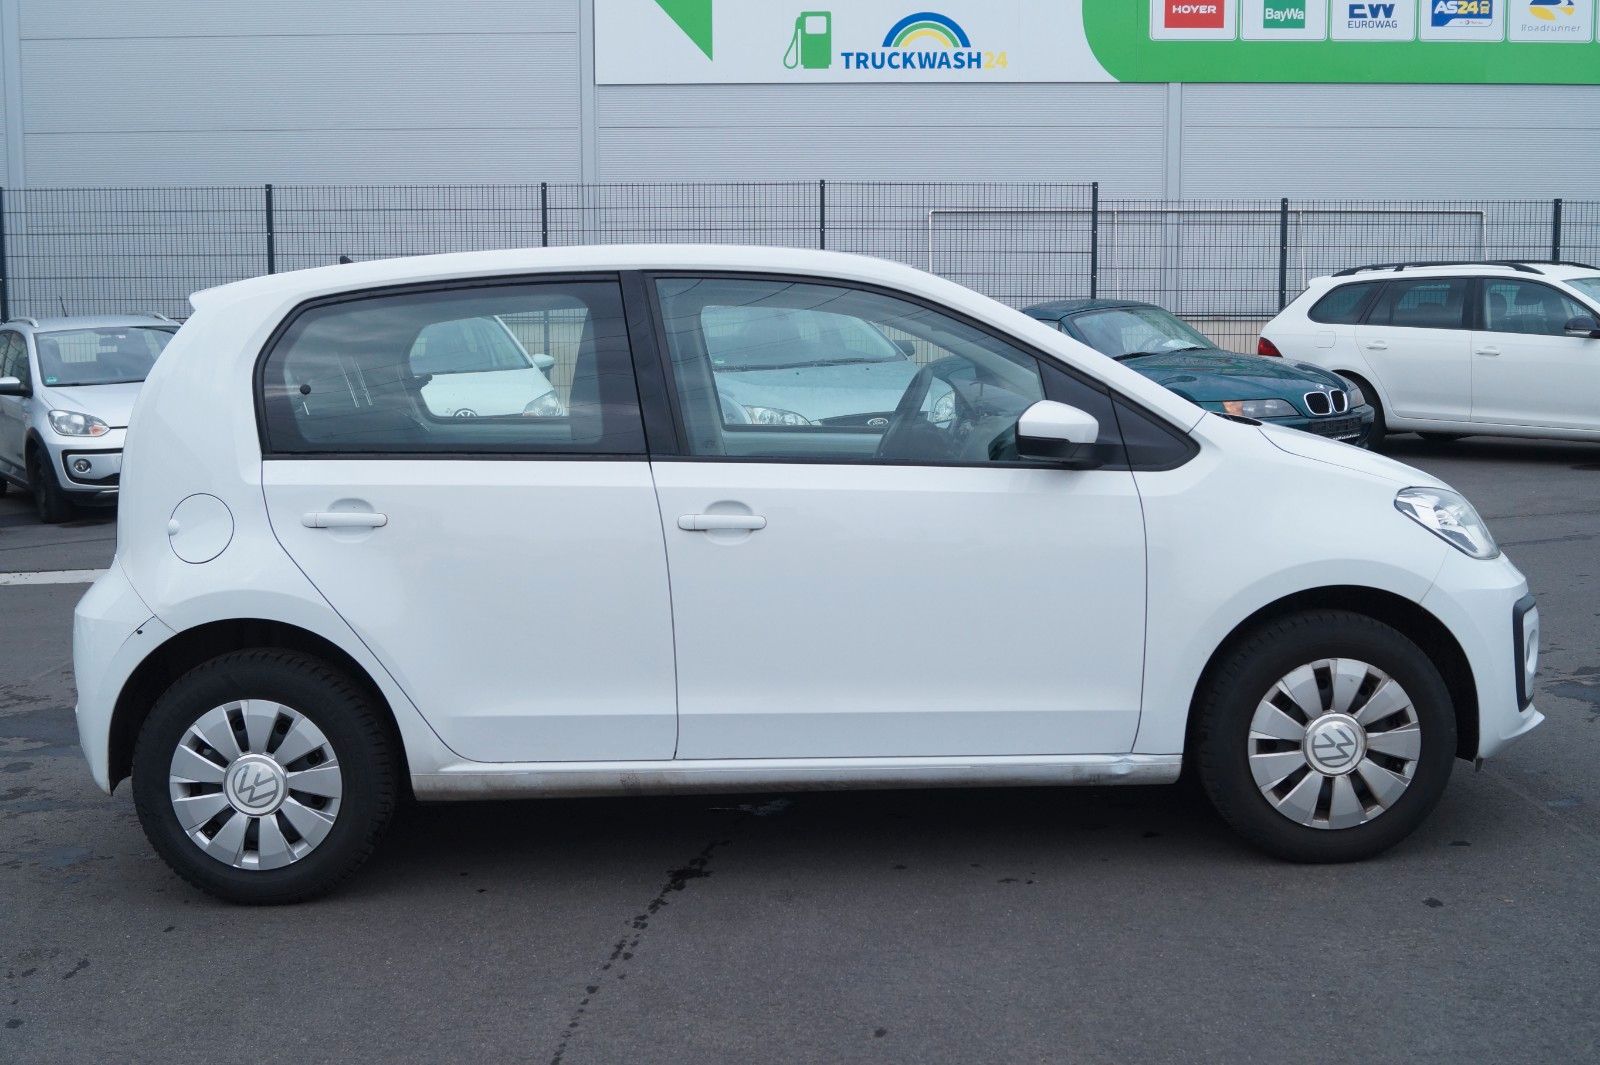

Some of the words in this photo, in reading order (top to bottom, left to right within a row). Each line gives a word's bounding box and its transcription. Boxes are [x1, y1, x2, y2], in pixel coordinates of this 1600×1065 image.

[1172, 5, 1217, 14] HOYER
[1434, 0, 1478, 14] AS24
[1265, 8, 1304, 21] BayWa
[1347, 20, 1398, 29] EUROWAG
[1520, 24, 1581, 32] Roadrunner
